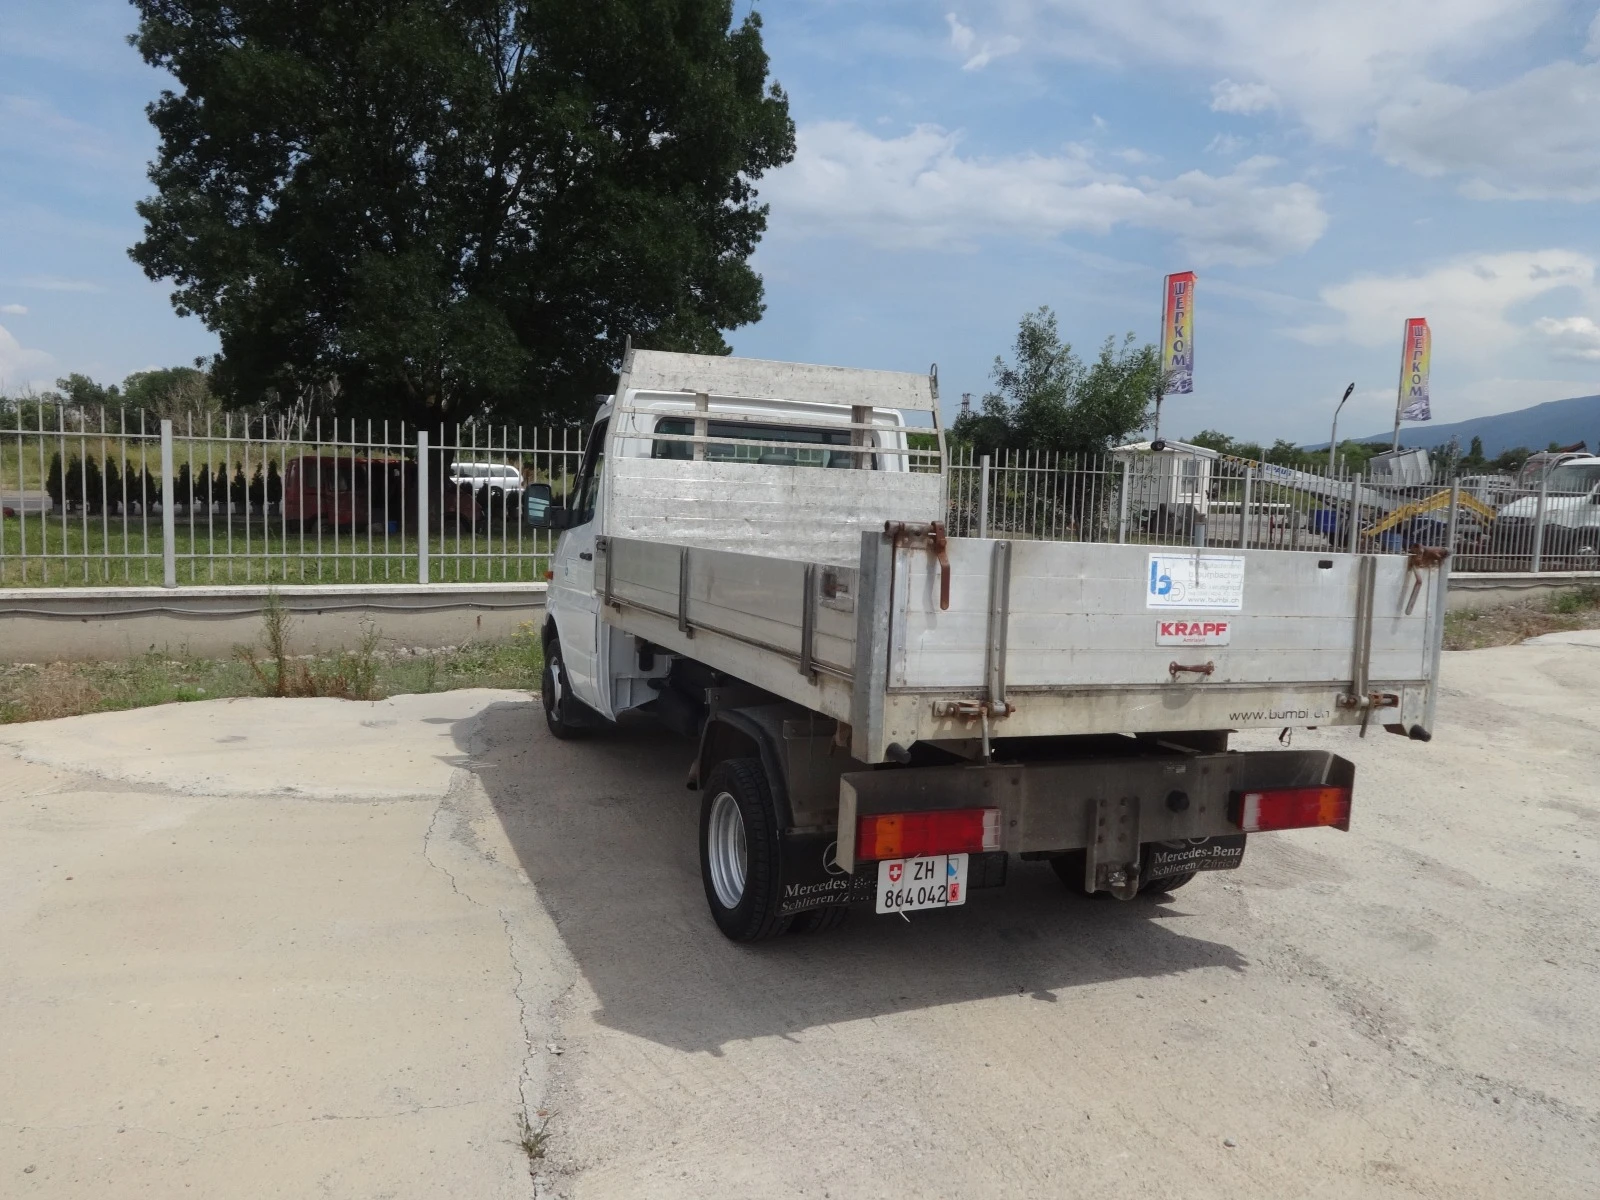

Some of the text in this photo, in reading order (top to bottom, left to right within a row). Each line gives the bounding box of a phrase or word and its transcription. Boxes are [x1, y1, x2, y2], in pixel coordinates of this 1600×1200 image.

[1160, 622, 1228, 636] KRAPF
[1154, 845, 1242, 863] Mercedes-Benz
[913, 860, 936, 881] ZH
